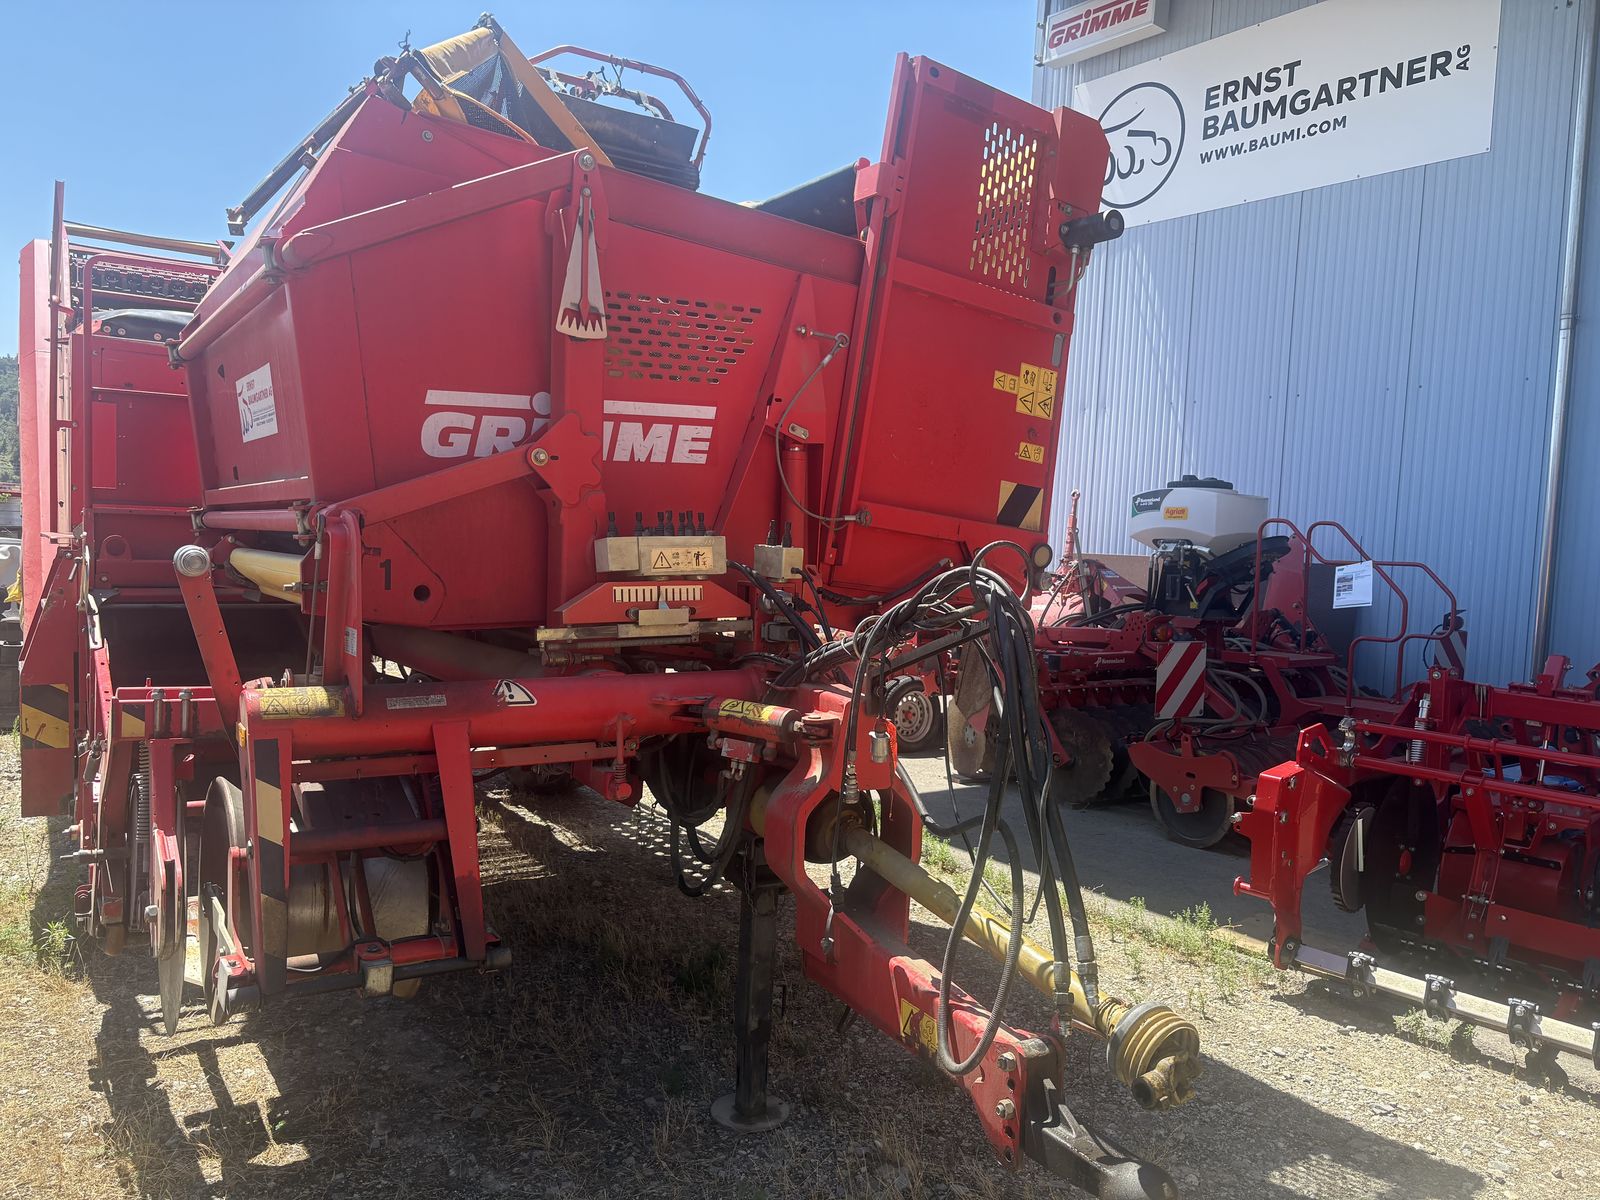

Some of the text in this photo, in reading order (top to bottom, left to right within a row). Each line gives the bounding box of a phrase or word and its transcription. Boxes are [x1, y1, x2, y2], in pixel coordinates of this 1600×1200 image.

[1049, 0, 1149, 49] GRIMME
[1202, 44, 1471, 140] BAUMGARTNER AG
[1204, 60, 1301, 111] ERNST
[1200, 115, 1347, 164] WWW.BAUMI.COM
[420, 391, 713, 464] GRIME
[379, 559, 392, 591] 1
